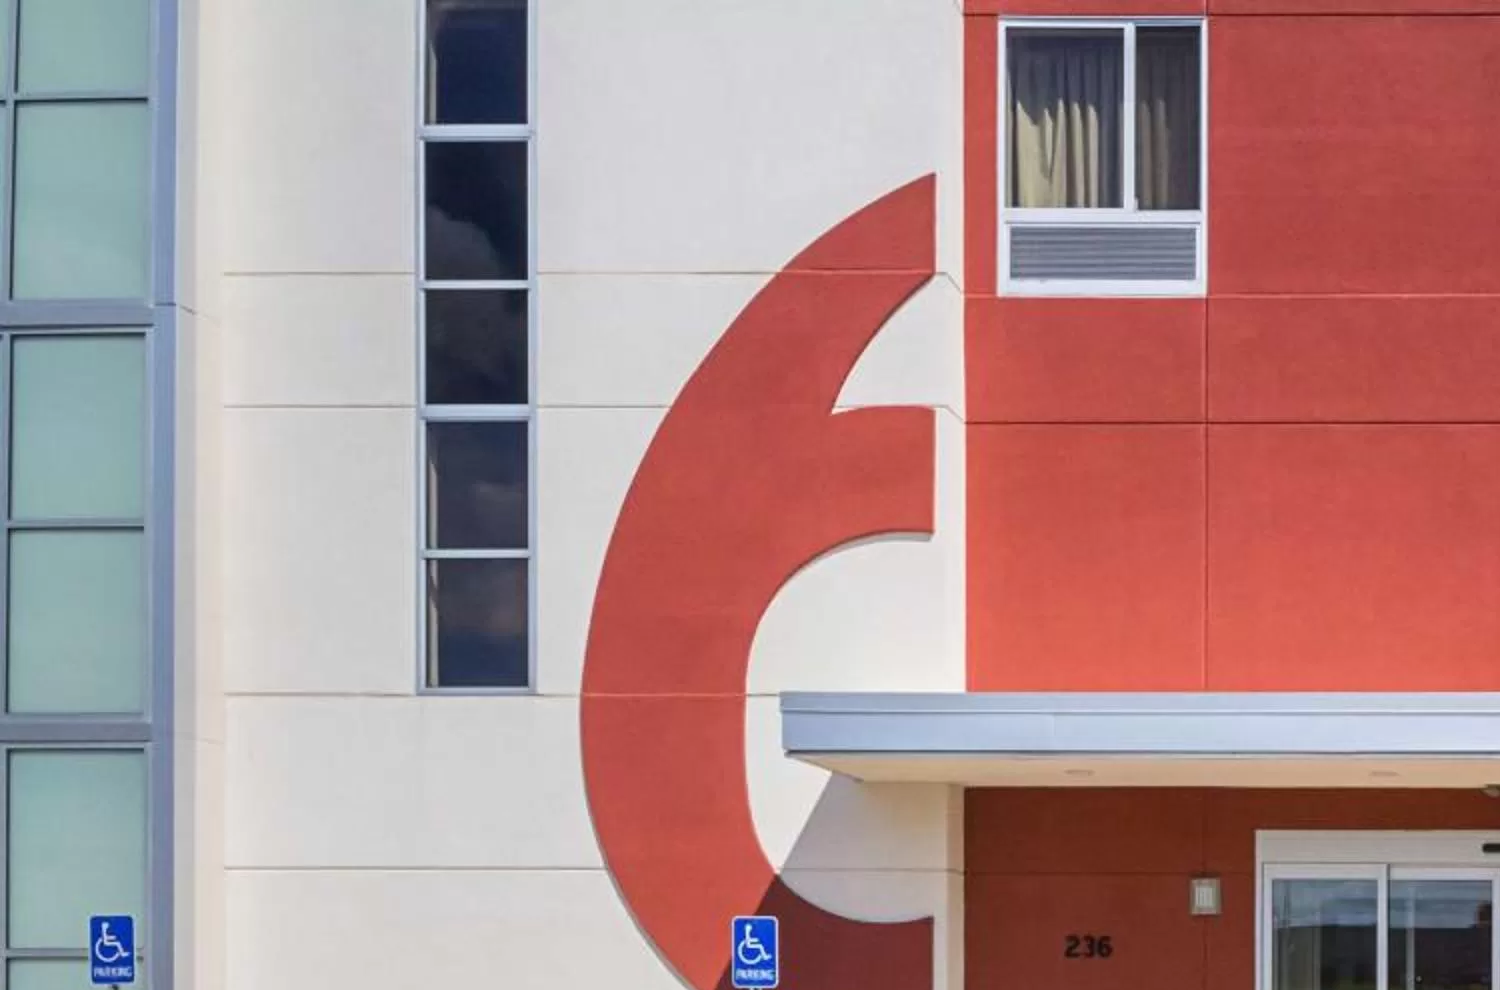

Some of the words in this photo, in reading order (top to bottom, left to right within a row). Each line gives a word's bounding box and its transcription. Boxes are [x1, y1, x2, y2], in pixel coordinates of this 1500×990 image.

[1064, 934, 1113, 959] 236
[93, 966, 132, 977] PARKING
[735, 968, 774, 980] PARKING
